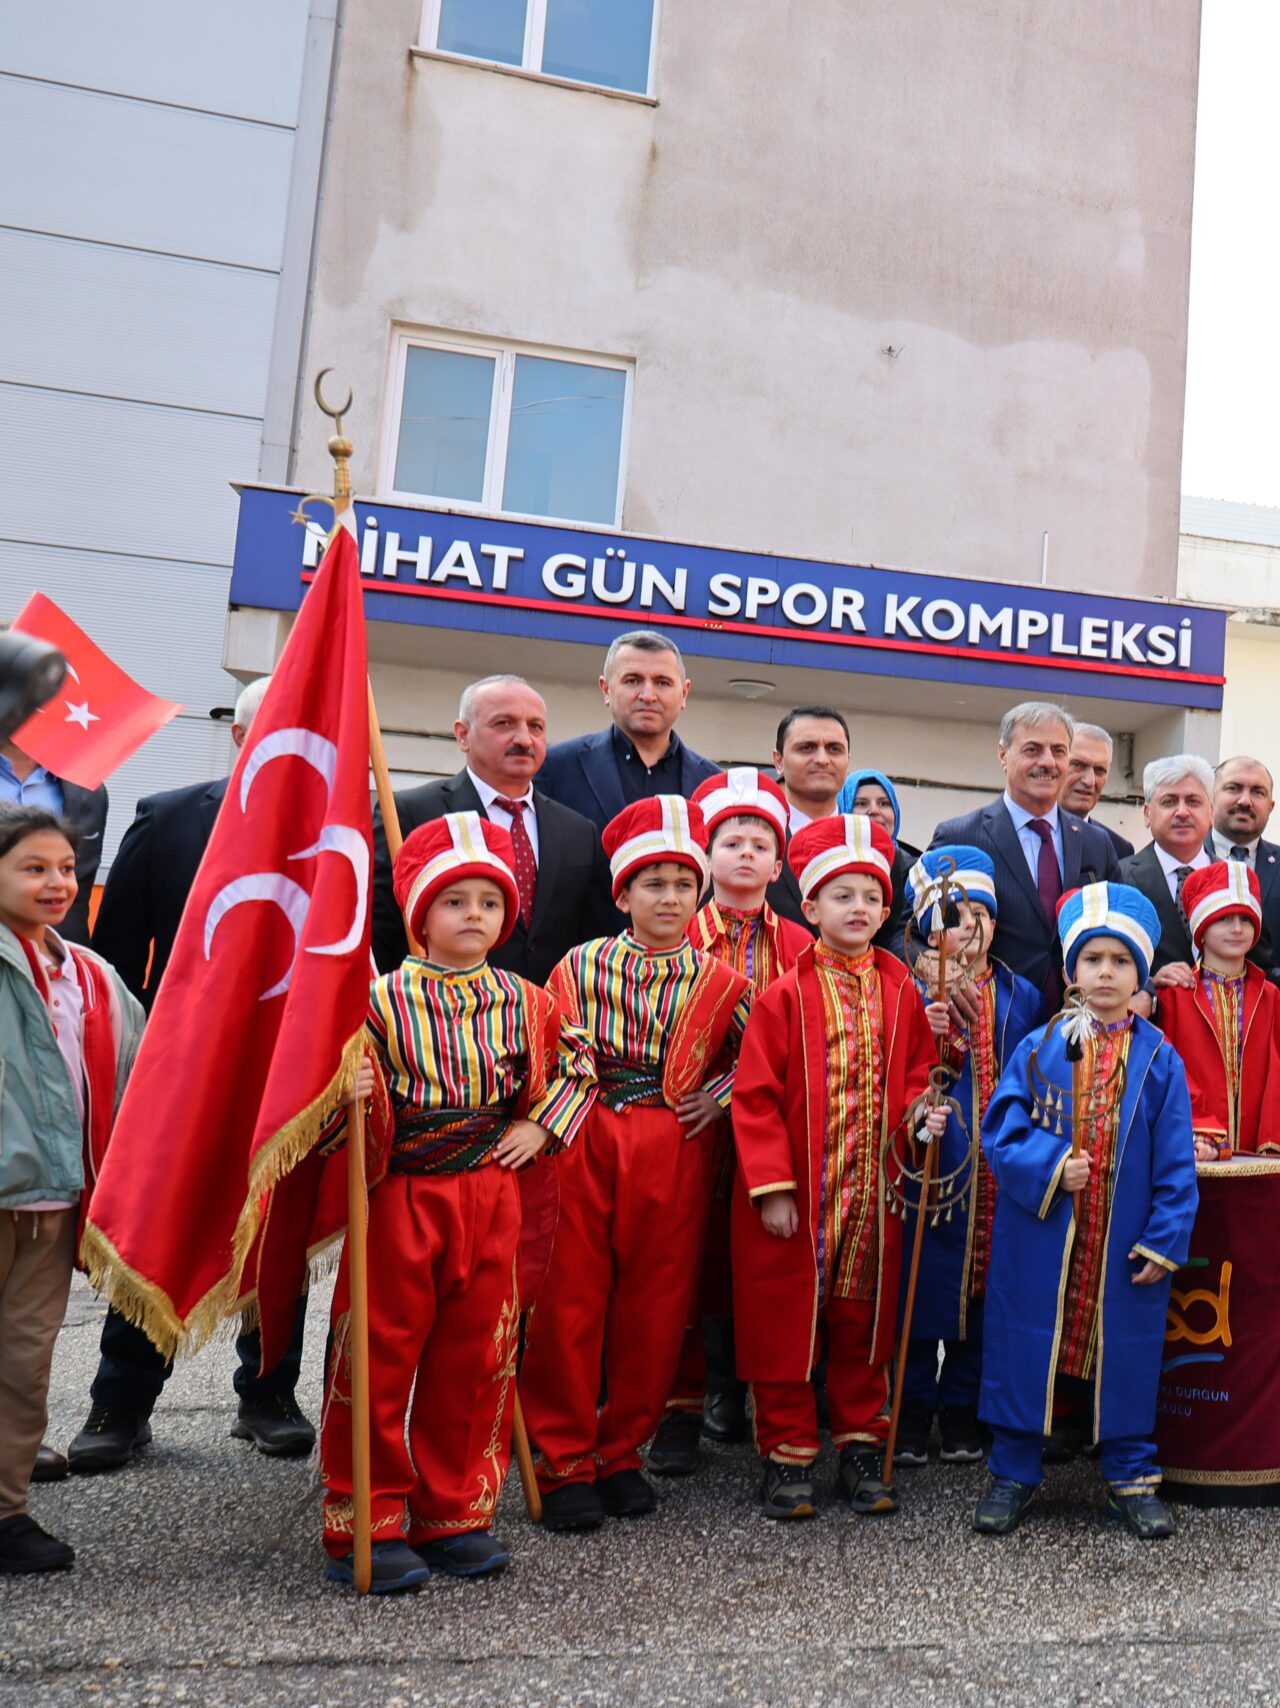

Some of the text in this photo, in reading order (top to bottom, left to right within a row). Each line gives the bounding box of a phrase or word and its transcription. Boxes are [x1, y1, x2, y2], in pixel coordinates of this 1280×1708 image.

[302, 516, 1192, 668] NİHAT GÜN SPOR KOMPLEKSİ
[1176, 1386, 1229, 1403] DURGUN
